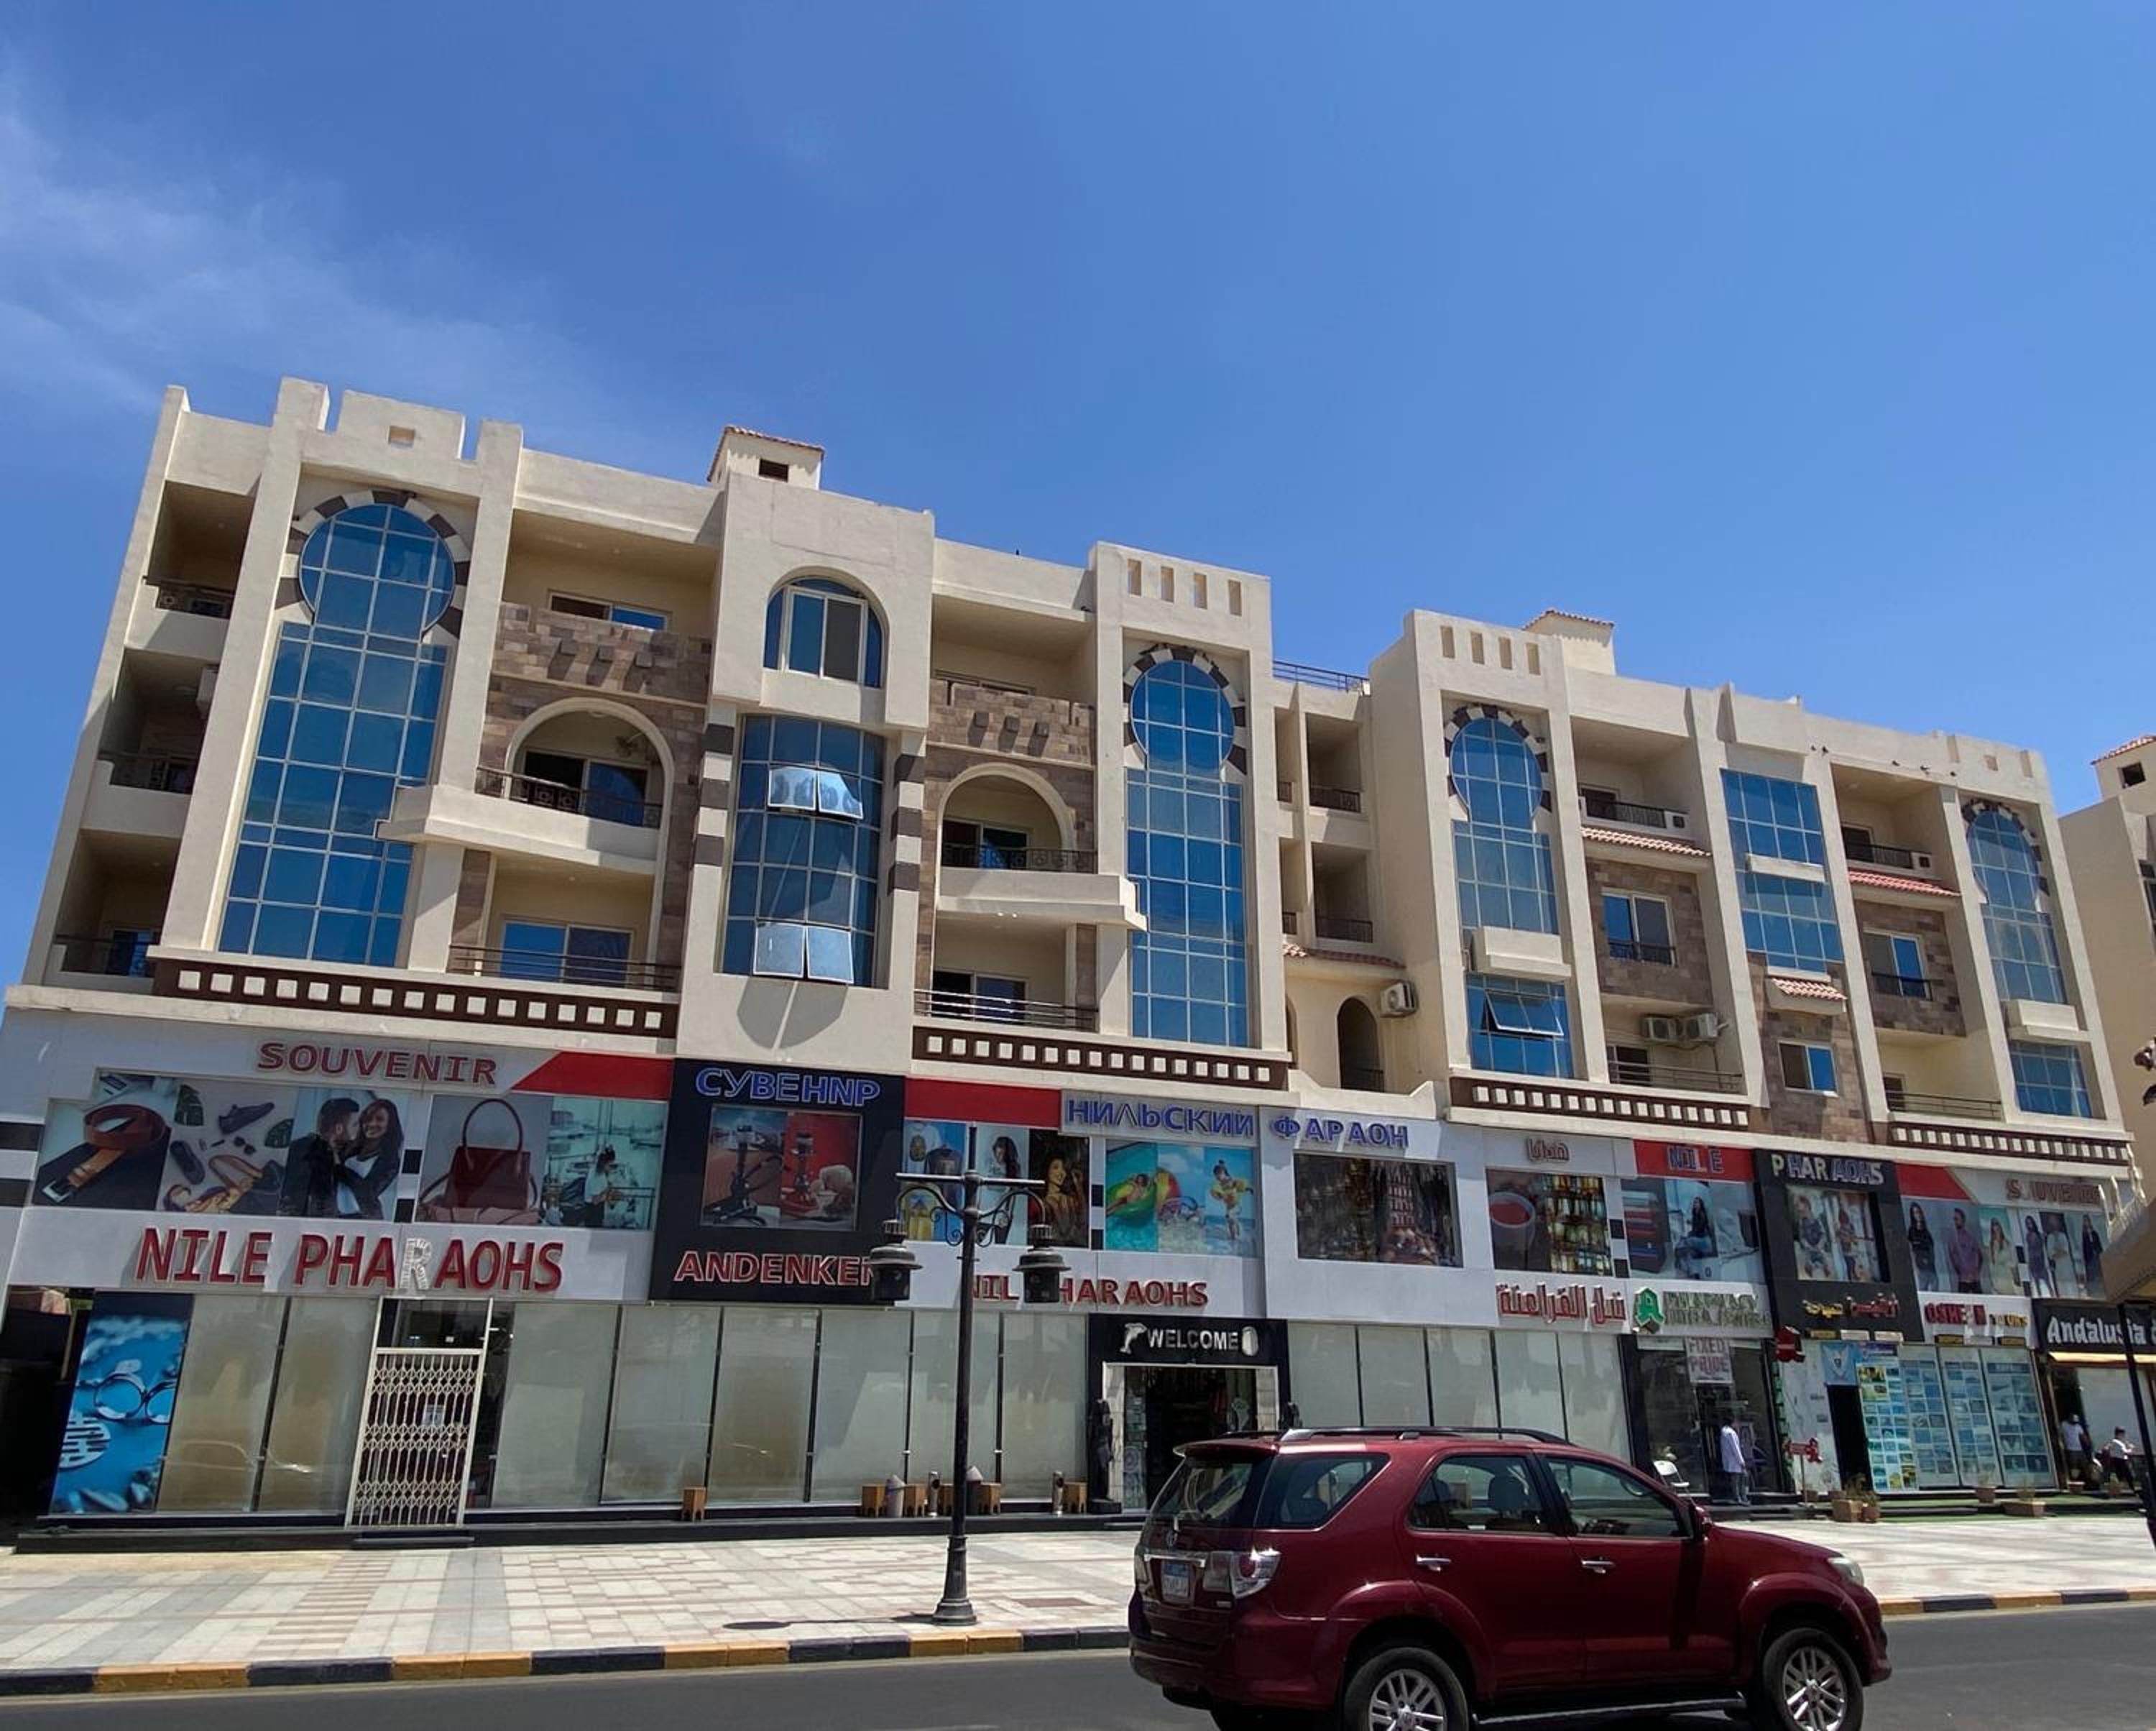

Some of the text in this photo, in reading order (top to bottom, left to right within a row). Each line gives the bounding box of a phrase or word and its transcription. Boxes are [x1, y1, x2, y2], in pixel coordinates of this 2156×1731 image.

[257, 1042, 499, 1085] SOUVENIR
[1271, 1116, 1409, 1149] ФАРАОН
[1667, 1145, 1725, 1175] NILE
[135, 1226, 565, 1292] NILE PHARAOHS
[973, 1275, 1209, 1307] IL HARAOHS
[1148, 1328, 1239, 1350] WELCOME
[2047, 1316, 2147, 1345] Andalusia
